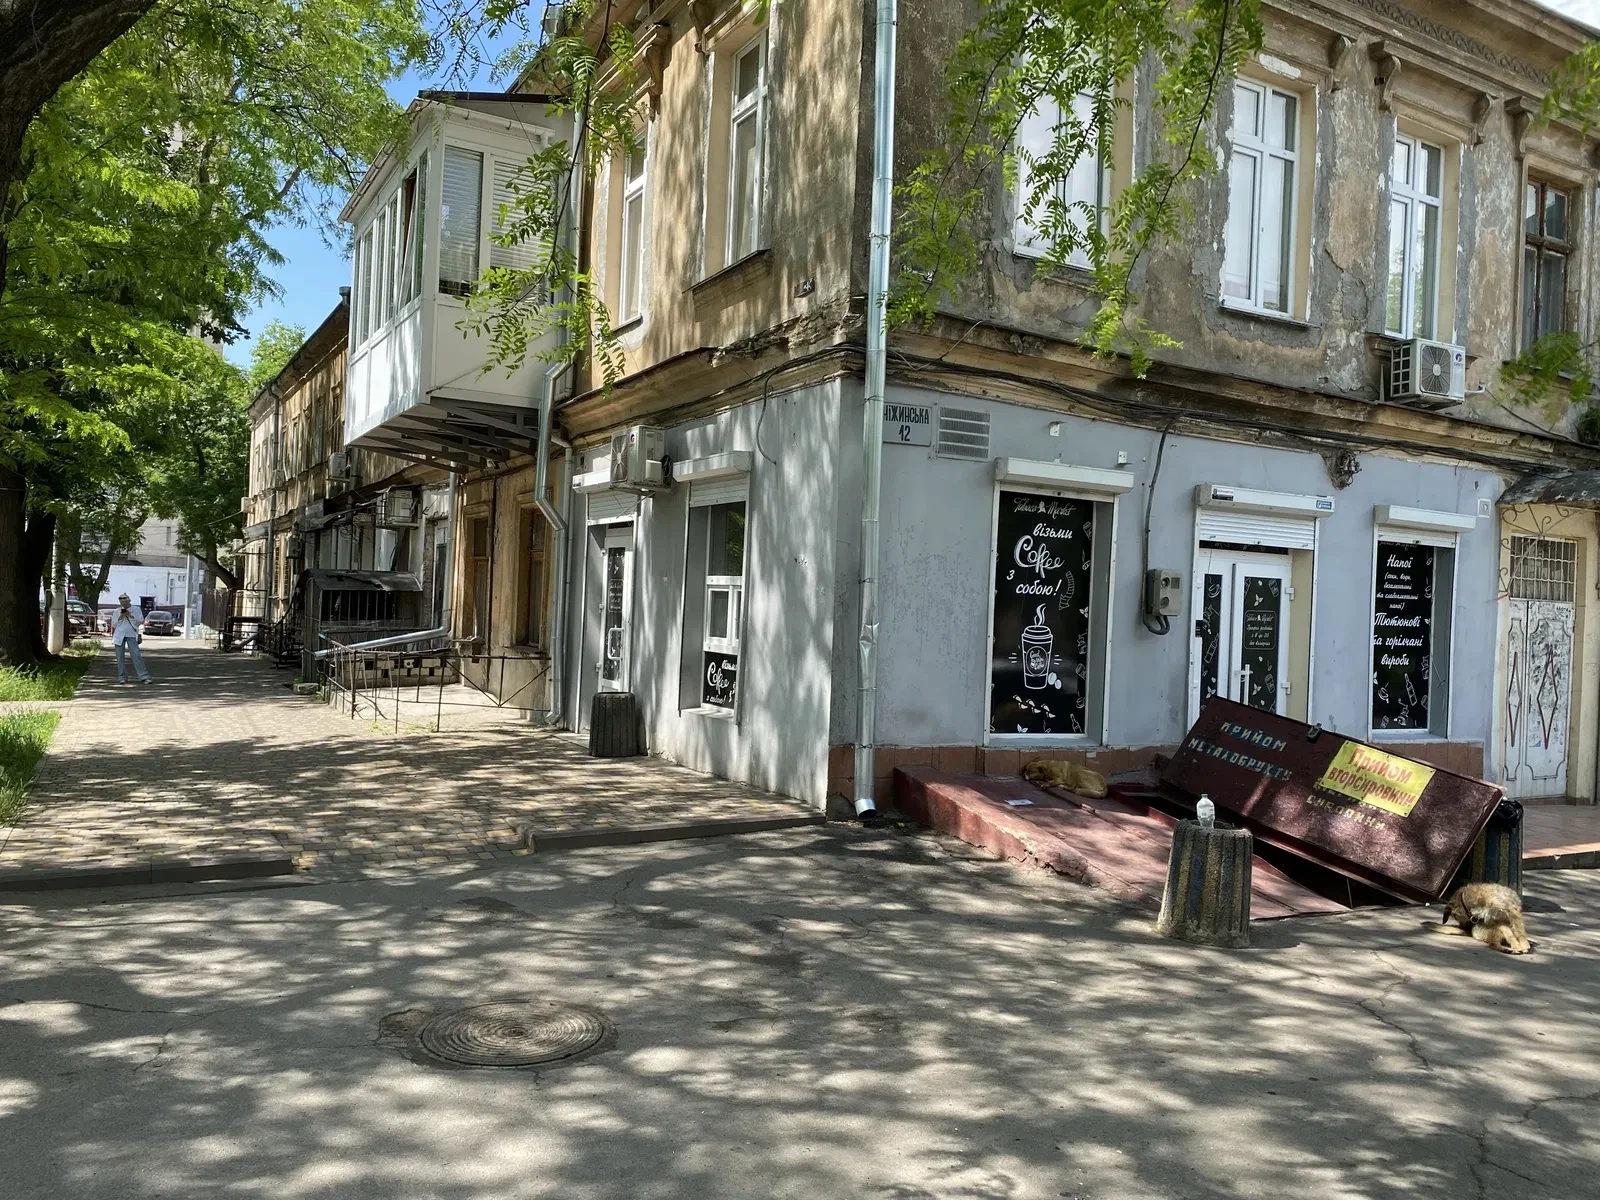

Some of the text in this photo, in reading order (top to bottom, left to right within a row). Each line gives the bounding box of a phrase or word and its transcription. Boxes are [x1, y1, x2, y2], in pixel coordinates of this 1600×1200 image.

[898, 424, 911, 442] 12
[1033, 523, 1073, 539] візьми
[1013, 535, 1065, 579] Coffee
[1386, 554, 1414, 568] Напої
[1016, 579, 1062, 596] собою!
[1373, 612, 1422, 627] Тютюнові
[1381, 653, 1410, 669] вироби
[707, 661, 730, 695] Coffee
[1221, 721, 1287, 752] ПРИЙОМ
[1348, 746, 1413, 784] Прийом
